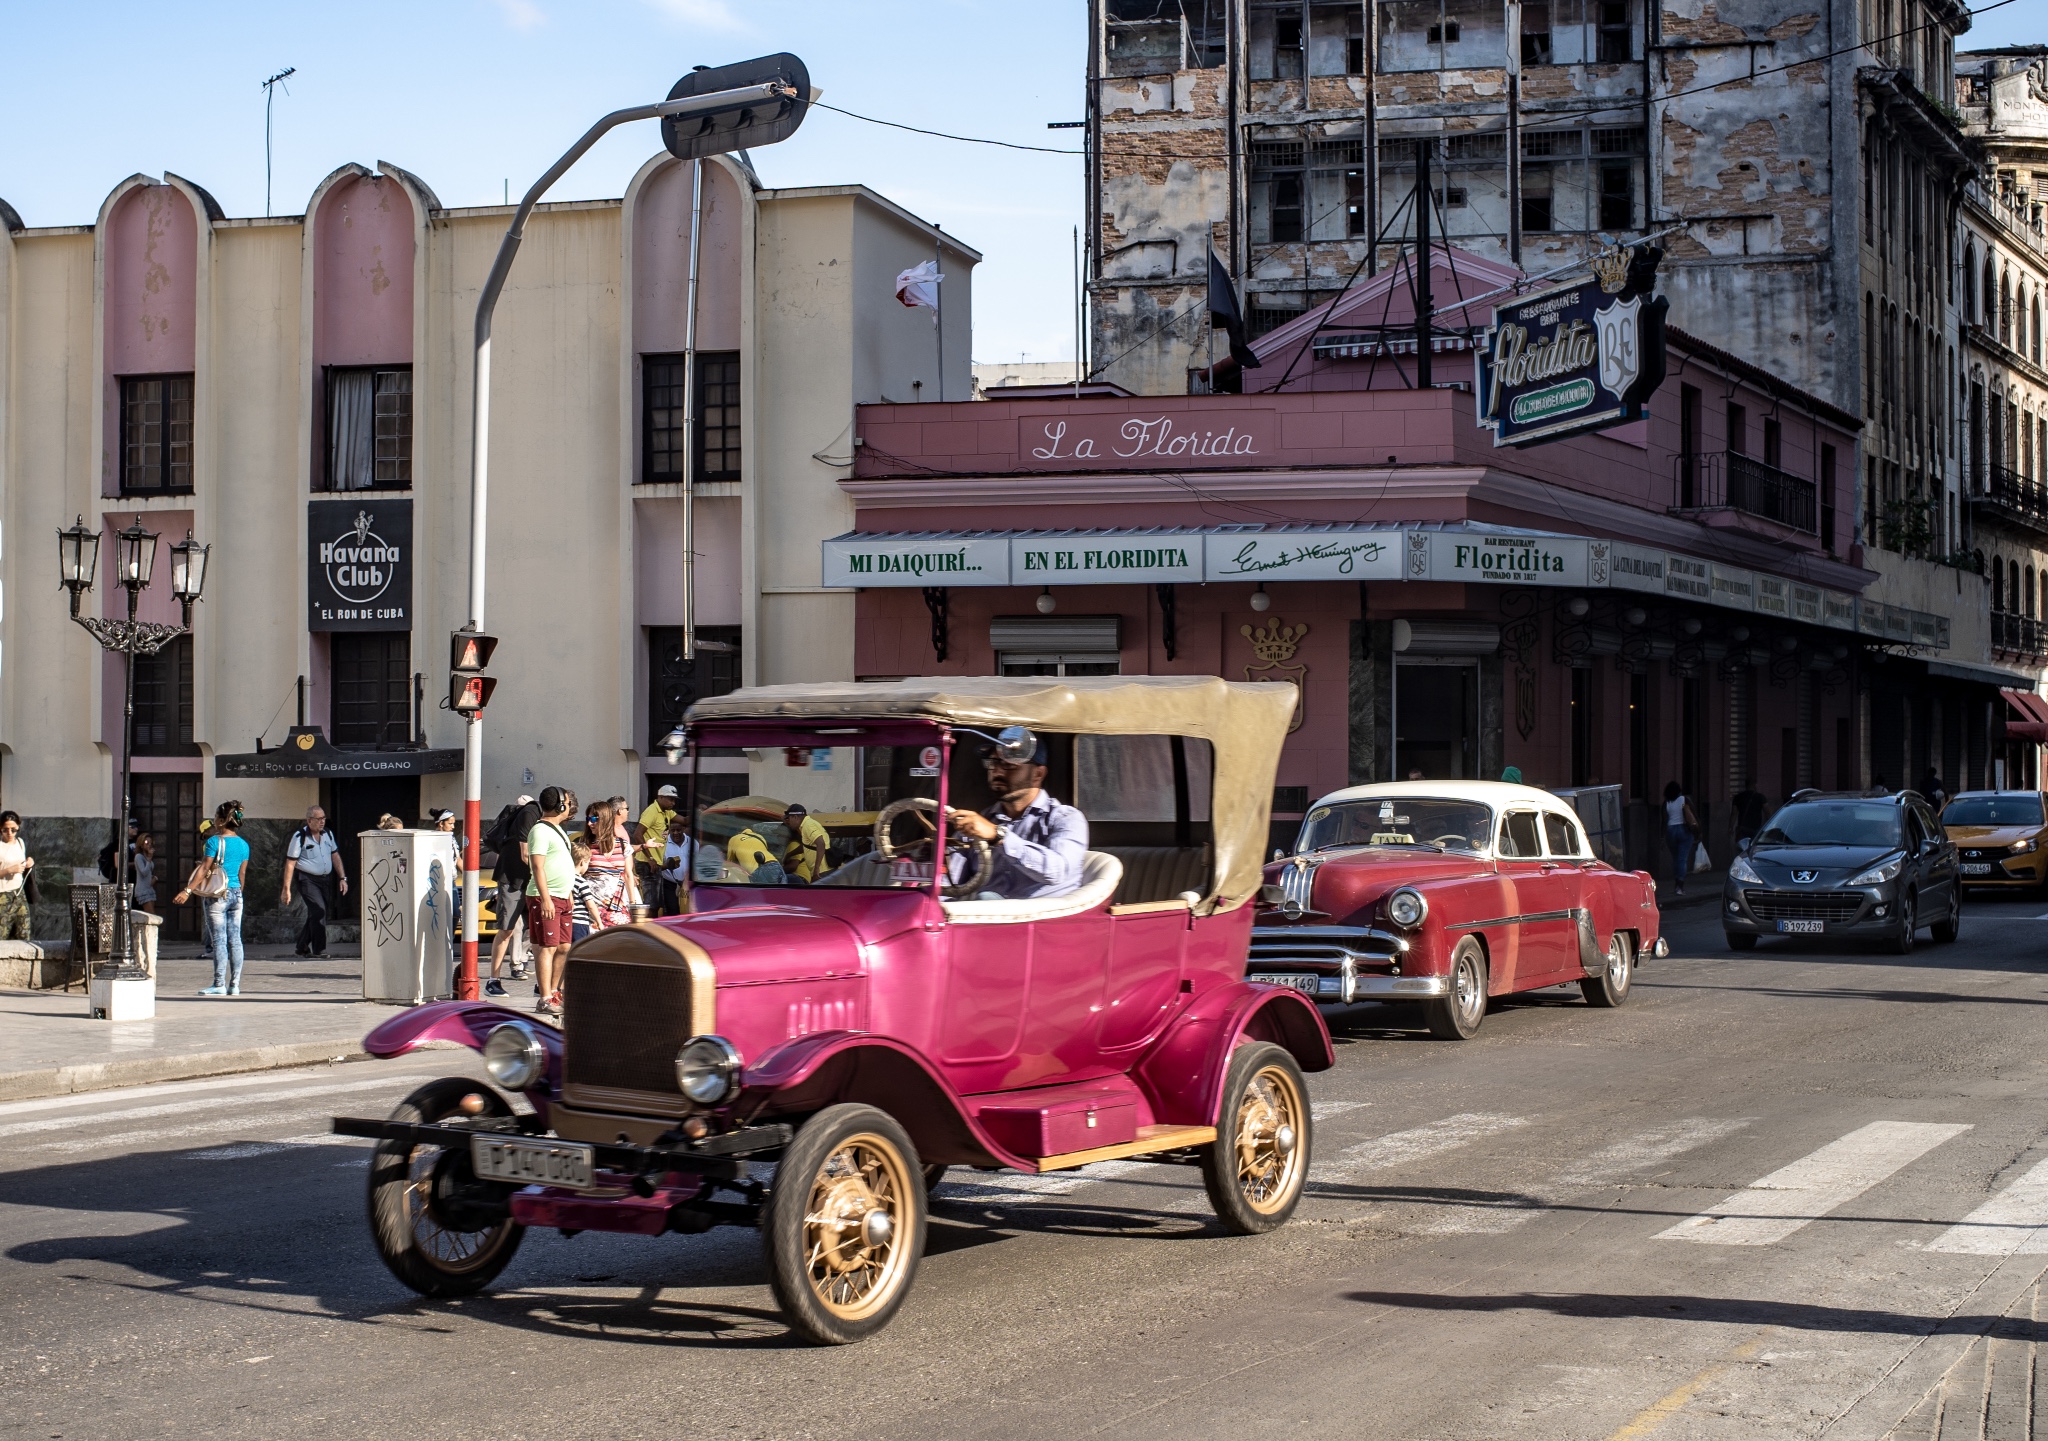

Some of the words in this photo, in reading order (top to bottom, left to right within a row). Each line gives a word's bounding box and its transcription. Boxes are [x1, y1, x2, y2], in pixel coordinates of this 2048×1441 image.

[1032, 421, 1101, 460] La
[1111, 416, 1260, 458] Florida
[1484, 538, 1497, 546] BAR
[1498, 538, 1536, 548] RESTAURANT
[319, 542, 400, 564] Havana
[1024, 552, 1049, 570] EN
[1054, 551, 1080, 570] EL
[1083, 548, 1189, 570] FLORIDITA
[1454, 545, 1565, 572] Floridita
[849, 554, 873, 573] MI
[336, 565, 383, 587] Club
[1482, 571, 1511, 580] FUNDADO
[1513, 572, 1522, 580] EN
[1523, 573, 1537, 581] 1817
[321, 609, 334, 620] EL
[337, 609, 358, 620] RON
[360, 608, 373, 619] DE
[376, 607, 404, 619] CUBA
[316, 762, 361, 771] TABACO
[362, 761, 411, 770] CUBANO
[1377, 836, 1405, 844] TAXI
